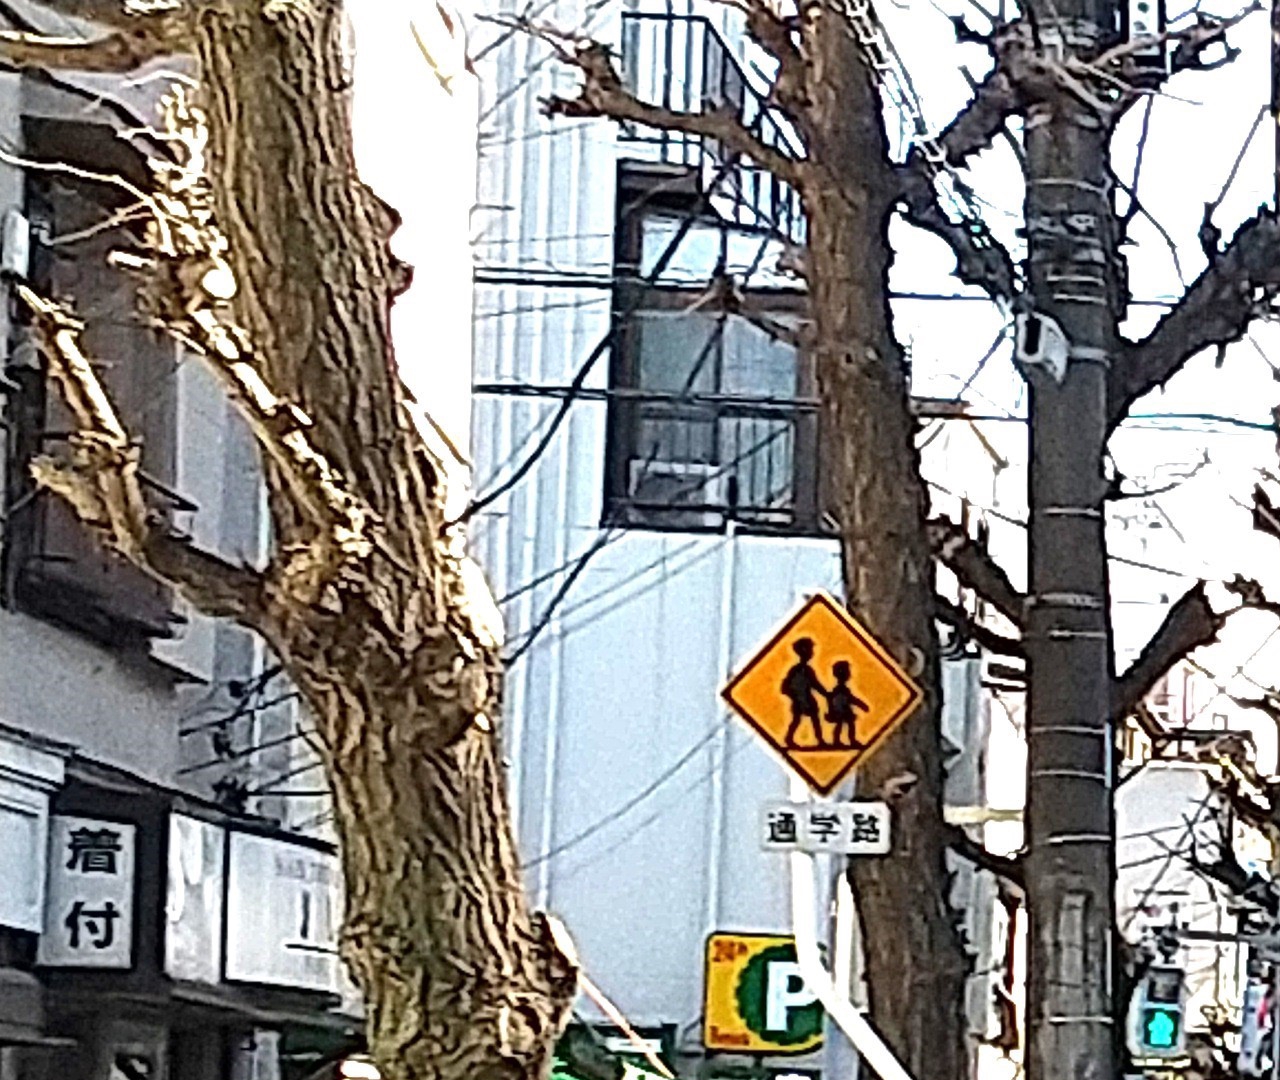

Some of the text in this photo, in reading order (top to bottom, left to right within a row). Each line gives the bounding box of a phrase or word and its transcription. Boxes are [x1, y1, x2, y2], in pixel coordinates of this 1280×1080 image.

[766, 812, 880, 843] 通学路
[63, 826, 124, 950] 着付
